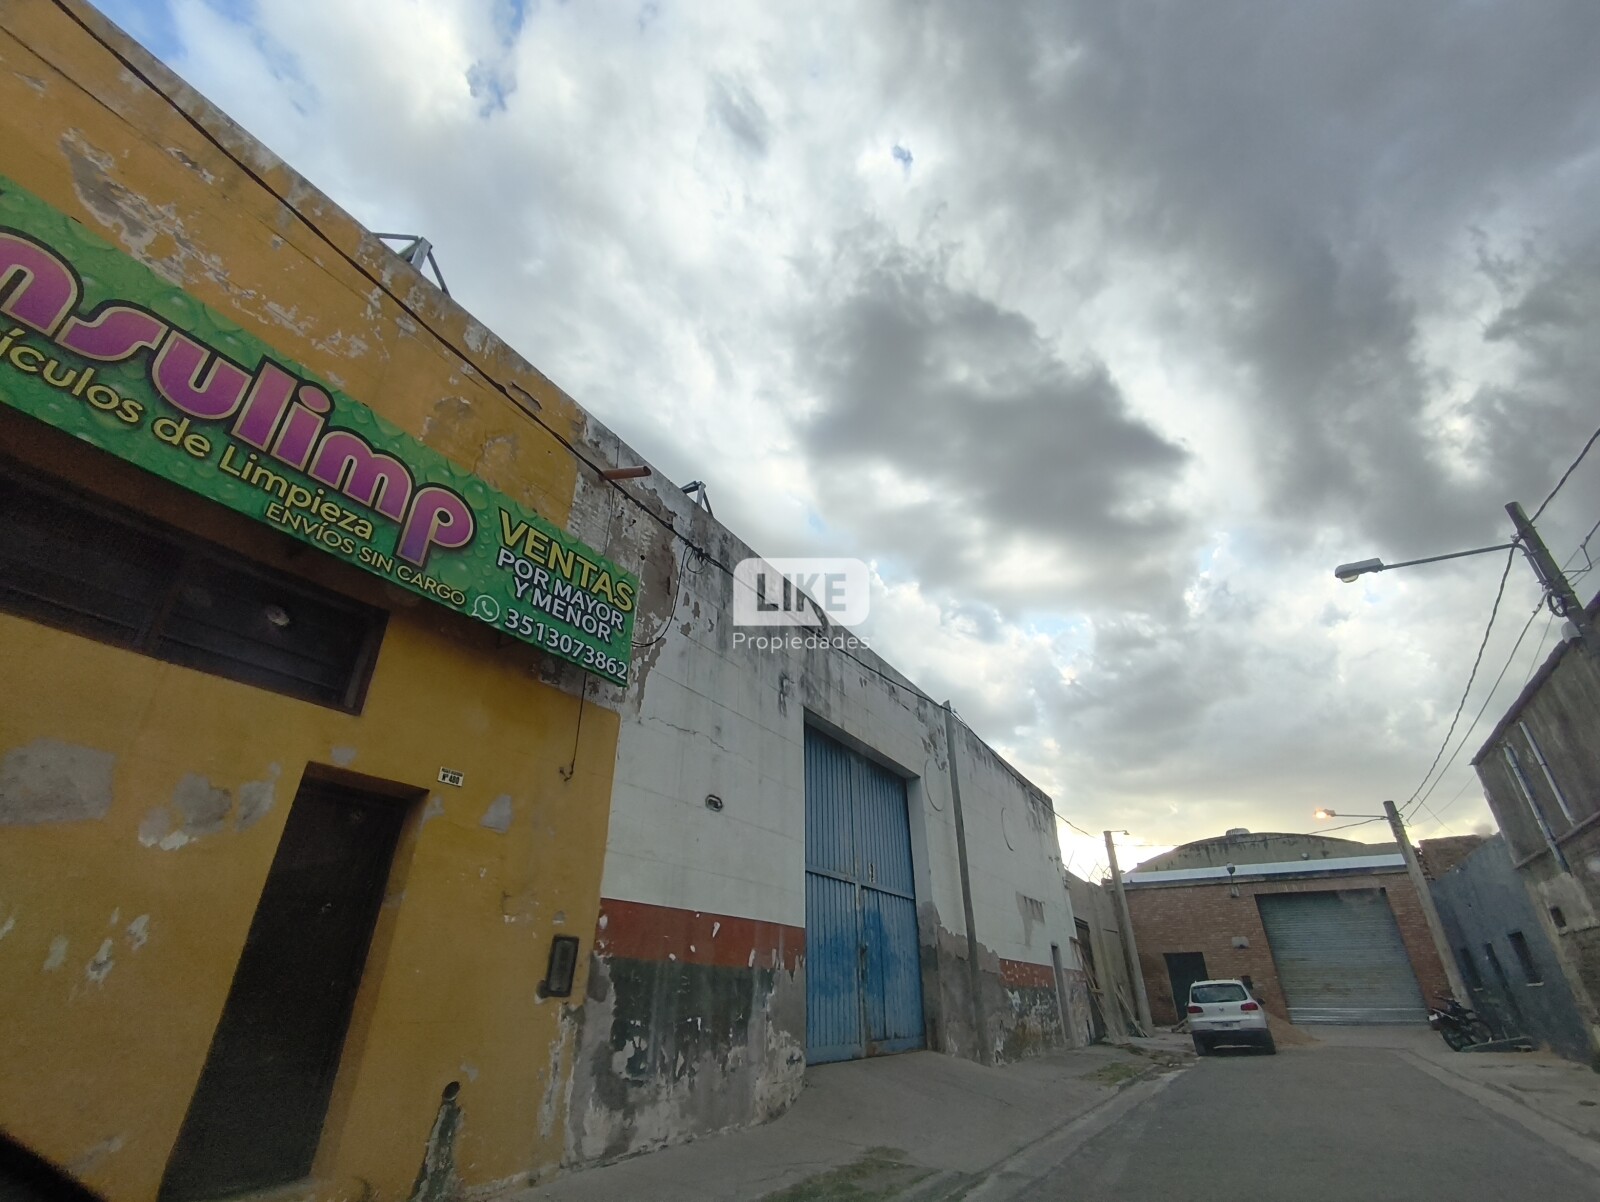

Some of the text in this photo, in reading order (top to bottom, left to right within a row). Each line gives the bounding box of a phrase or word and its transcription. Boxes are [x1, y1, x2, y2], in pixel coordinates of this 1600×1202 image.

[152, 416, 212, 458] de
[219, 444, 374, 540] Limpieza
[265, 501, 467, 606] ENVÍOS SIN CARGO
[497, 548, 624, 631] POR MAYOR
[499, 507, 635, 612] VENTAS
[504, 608, 627, 679] 3513073862
[514, 577, 612, 643] Y MENOR
